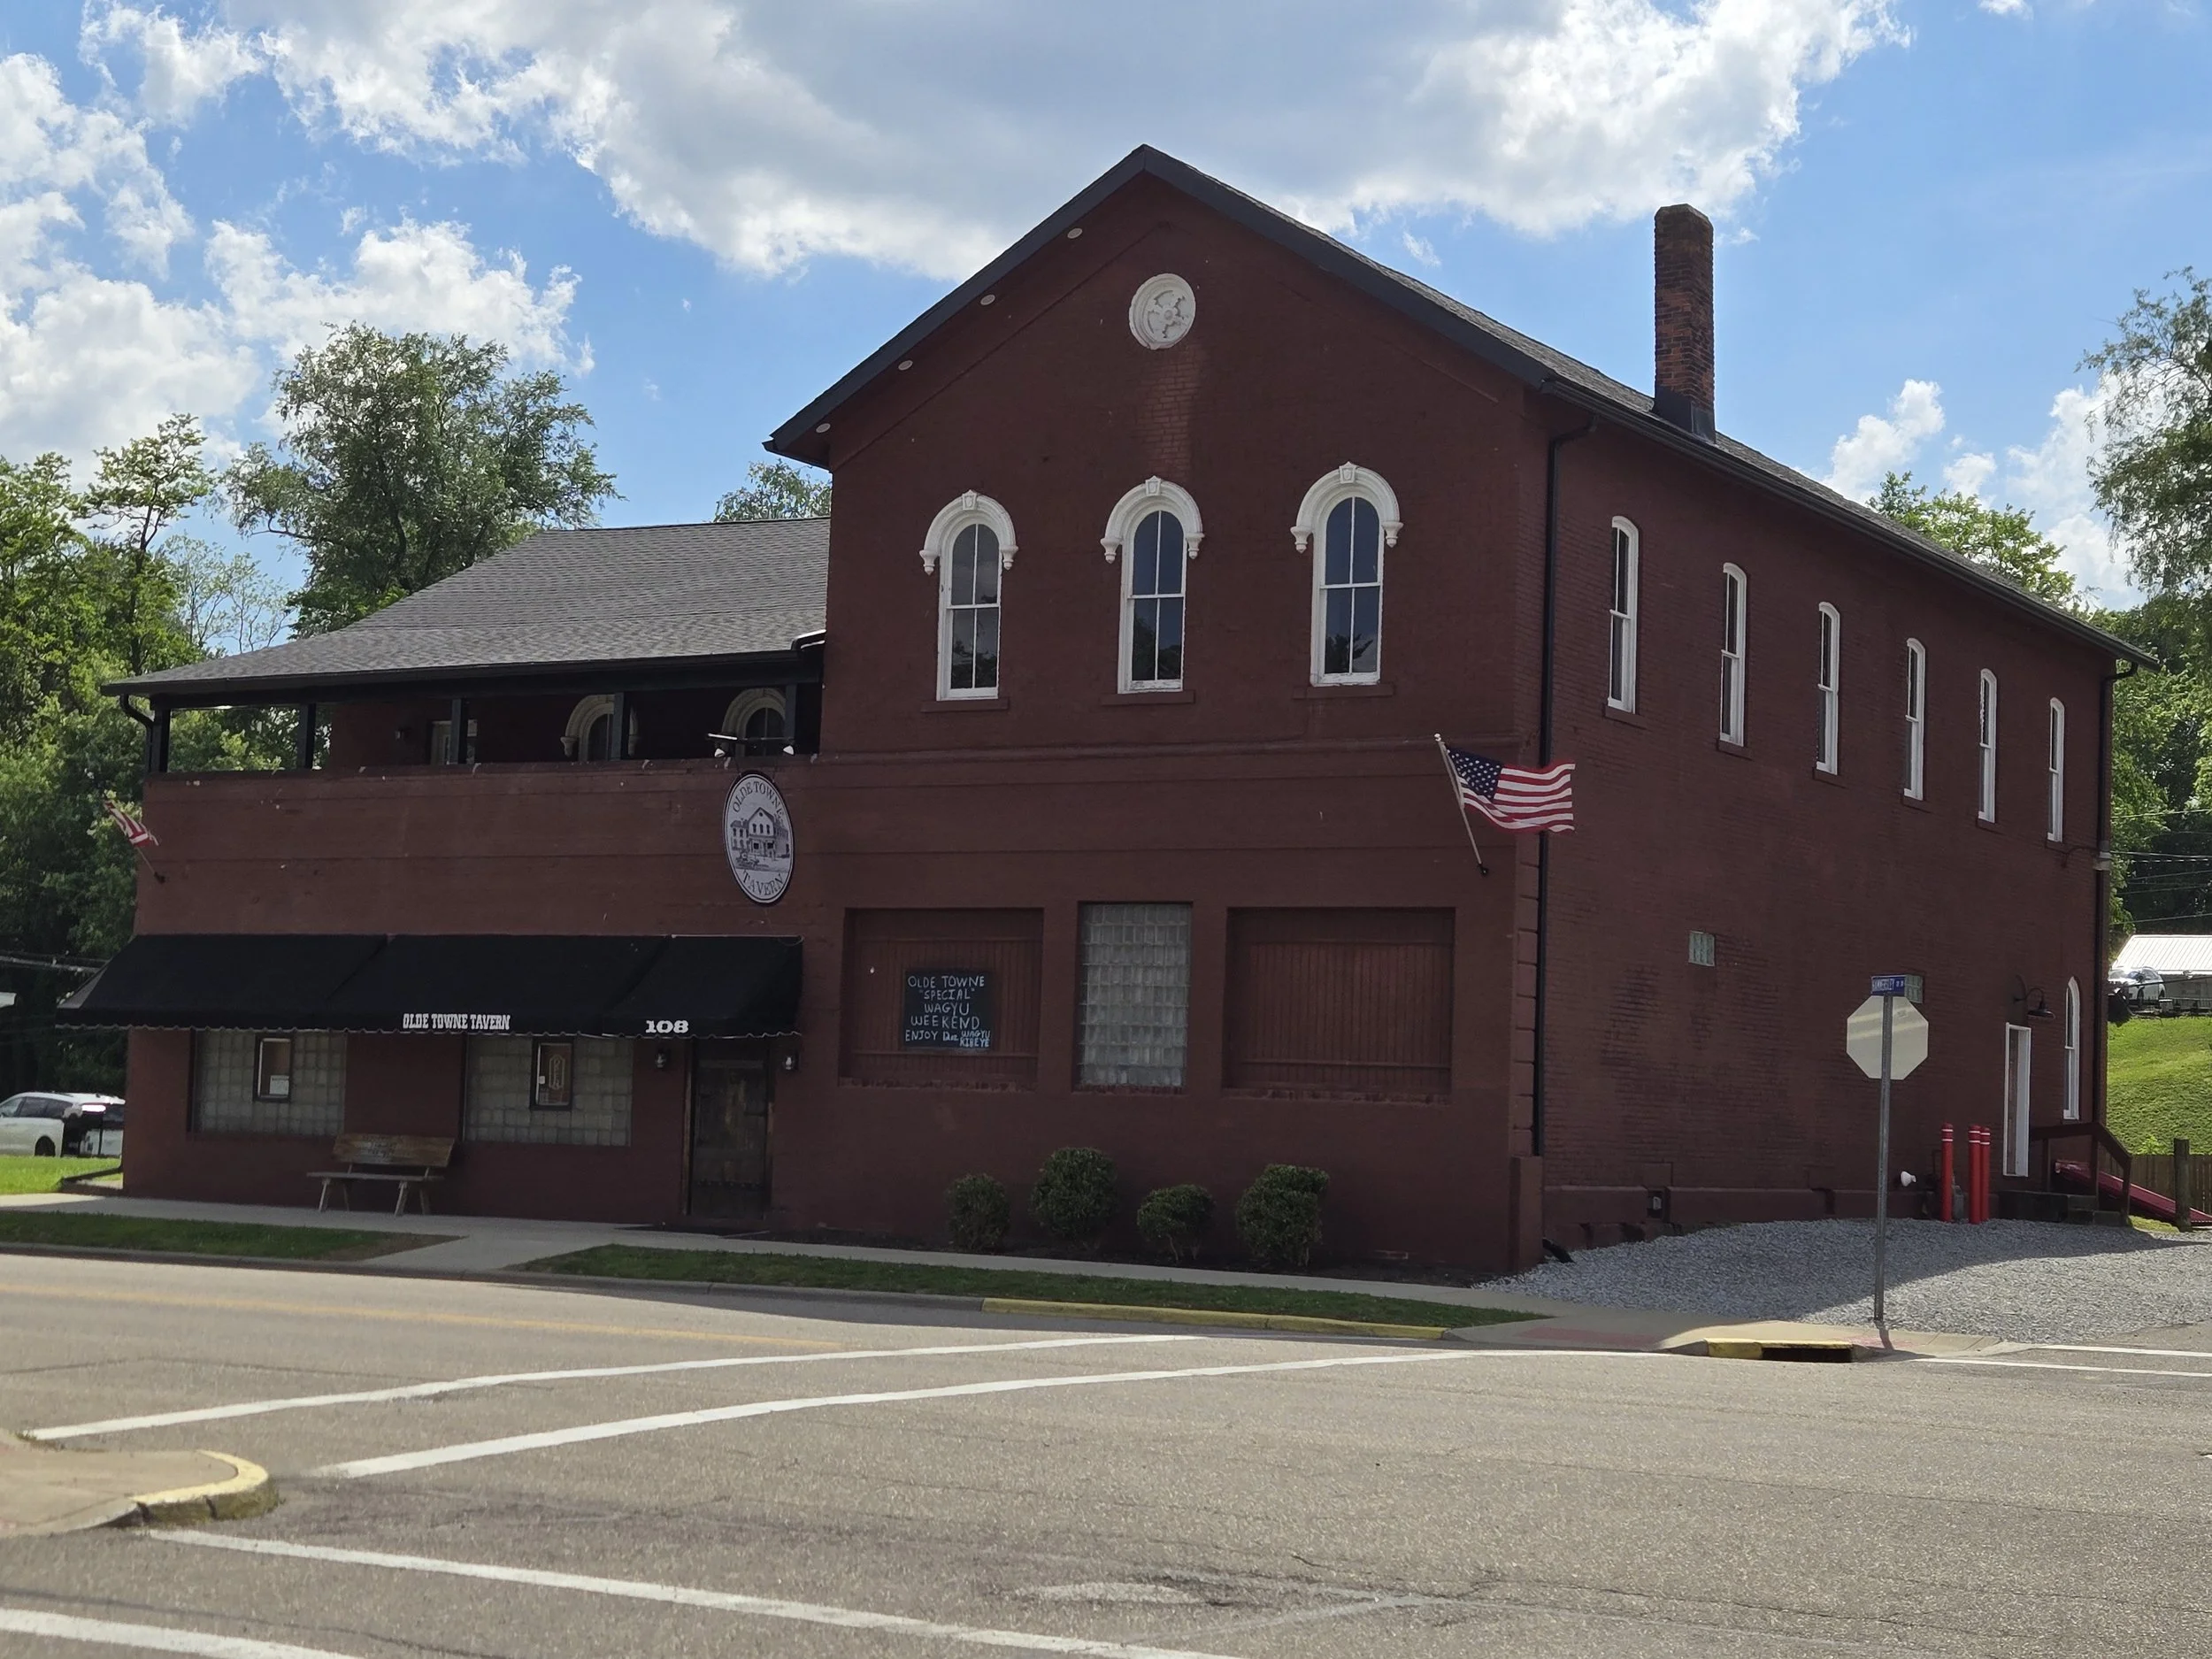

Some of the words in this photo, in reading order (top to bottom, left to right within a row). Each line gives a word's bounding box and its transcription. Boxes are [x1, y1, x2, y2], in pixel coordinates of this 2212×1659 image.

[733, 781, 753, 813] OLDE
[753, 780, 785, 819] TOWNE
[741, 870, 784, 896] TAVERN
[907, 975, 936, 988] OLDE
[941, 975, 985, 988] TOWNE
[924, 1002, 970, 1016] WAGYU
[403, 1013, 429, 1028] OLDE
[431, 1013, 468, 1029] TOWNE
[470, 1014, 511, 1030] TAVERN
[645, 1019, 689, 1033] 108
[910, 1015, 980, 1030] WEEKEND
[905, 1029, 938, 1041] ENJOY
[961, 1029, 991, 1039] WAGYU
[959, 1037, 990, 1048] RIBEYE
